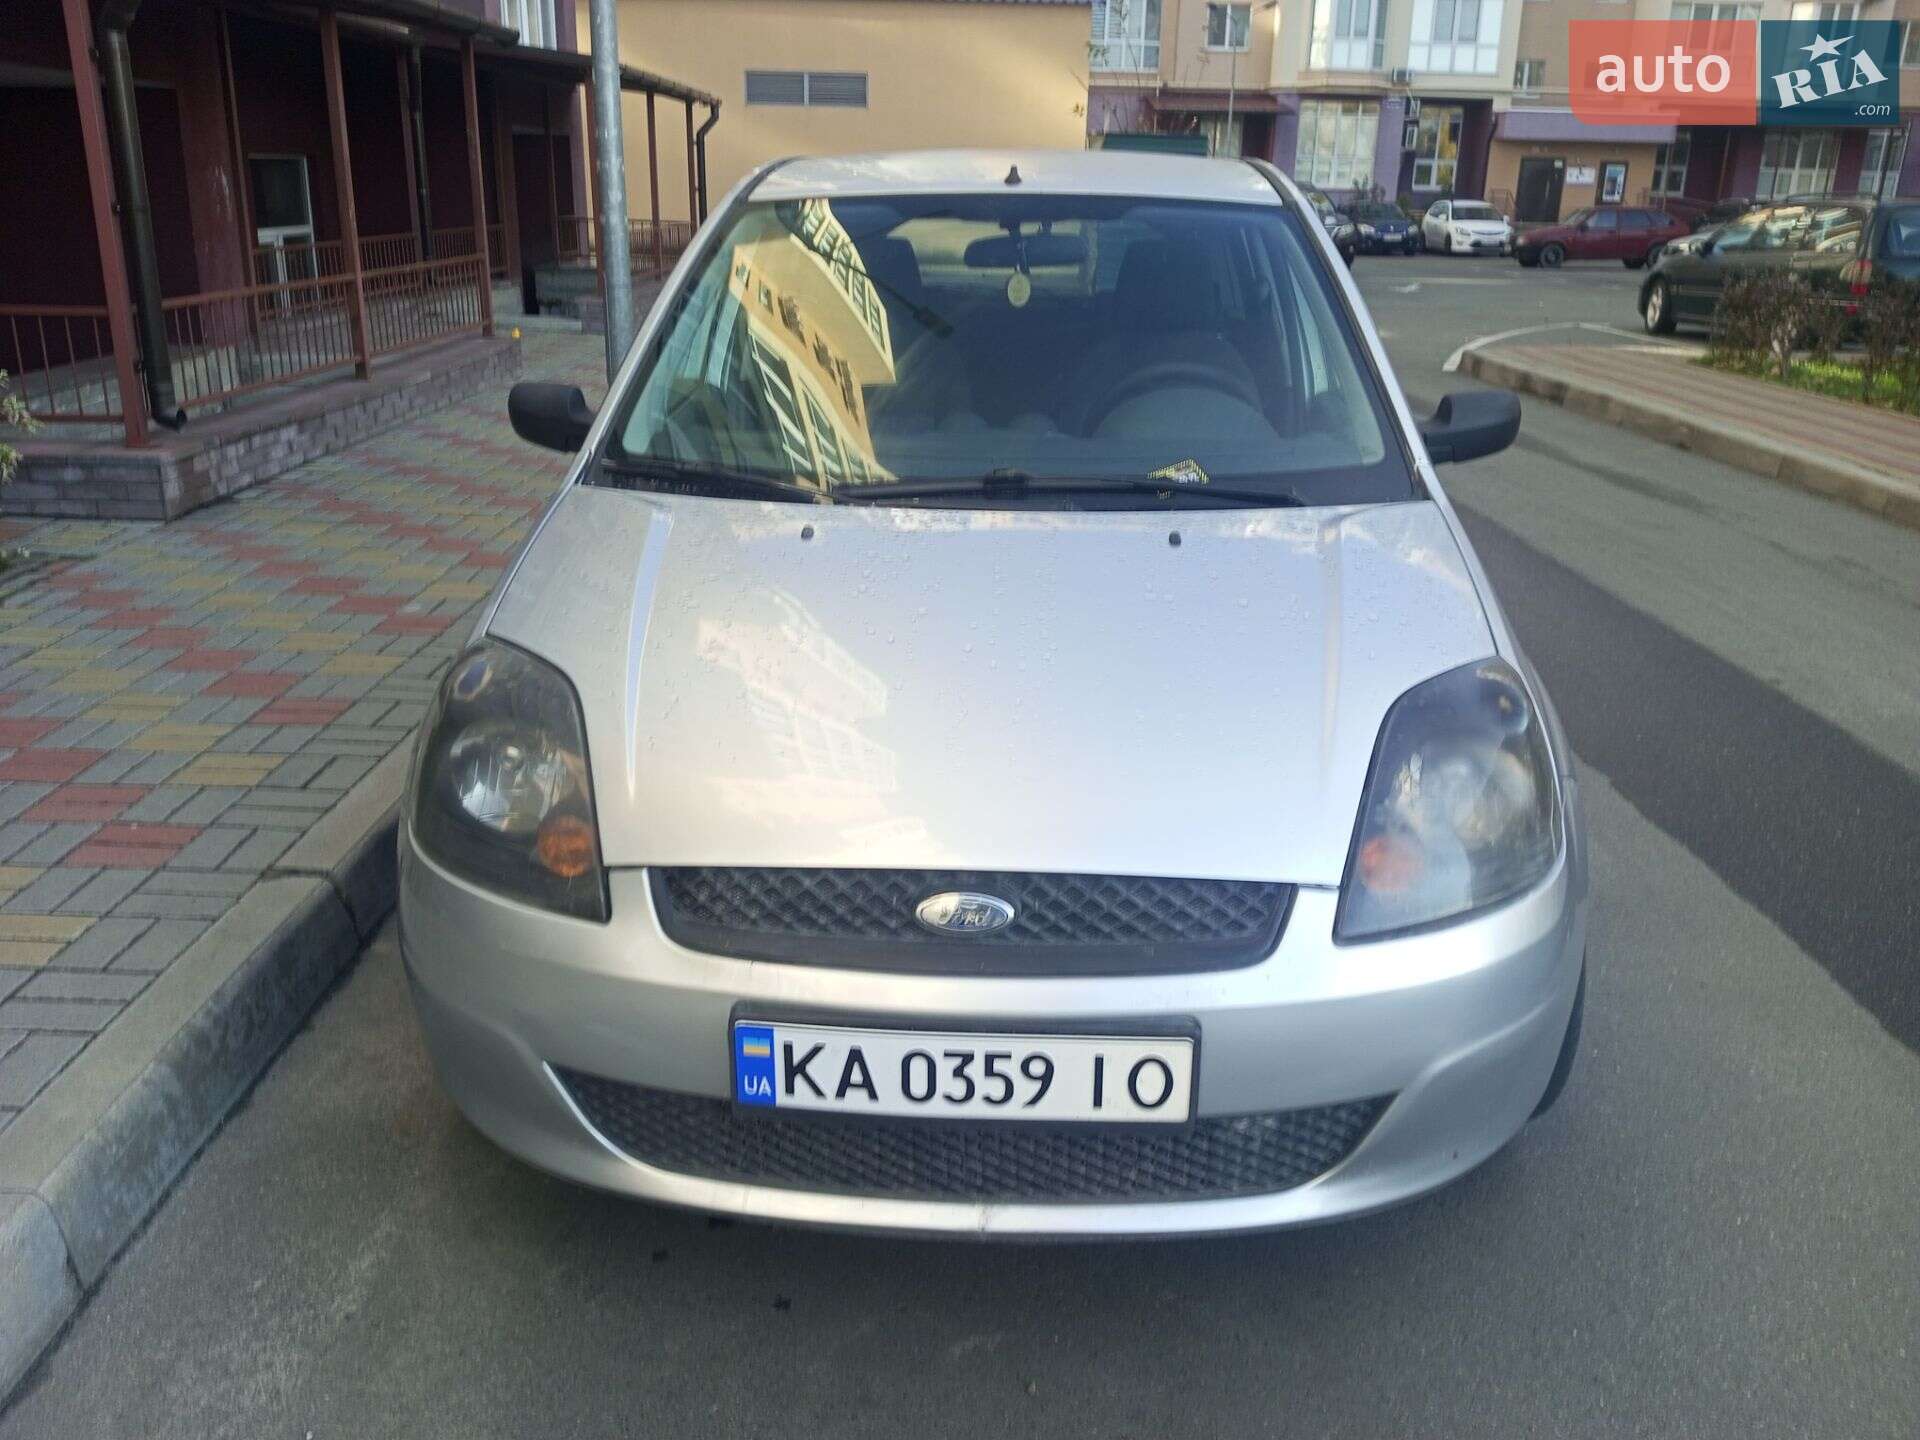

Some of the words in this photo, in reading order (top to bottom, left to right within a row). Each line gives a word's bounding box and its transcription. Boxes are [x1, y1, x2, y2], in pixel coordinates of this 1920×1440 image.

[743, 1074, 772, 1096] UA
[783, 1040, 879, 1103] KA
[901, 1049, 1055, 1109] 0359
